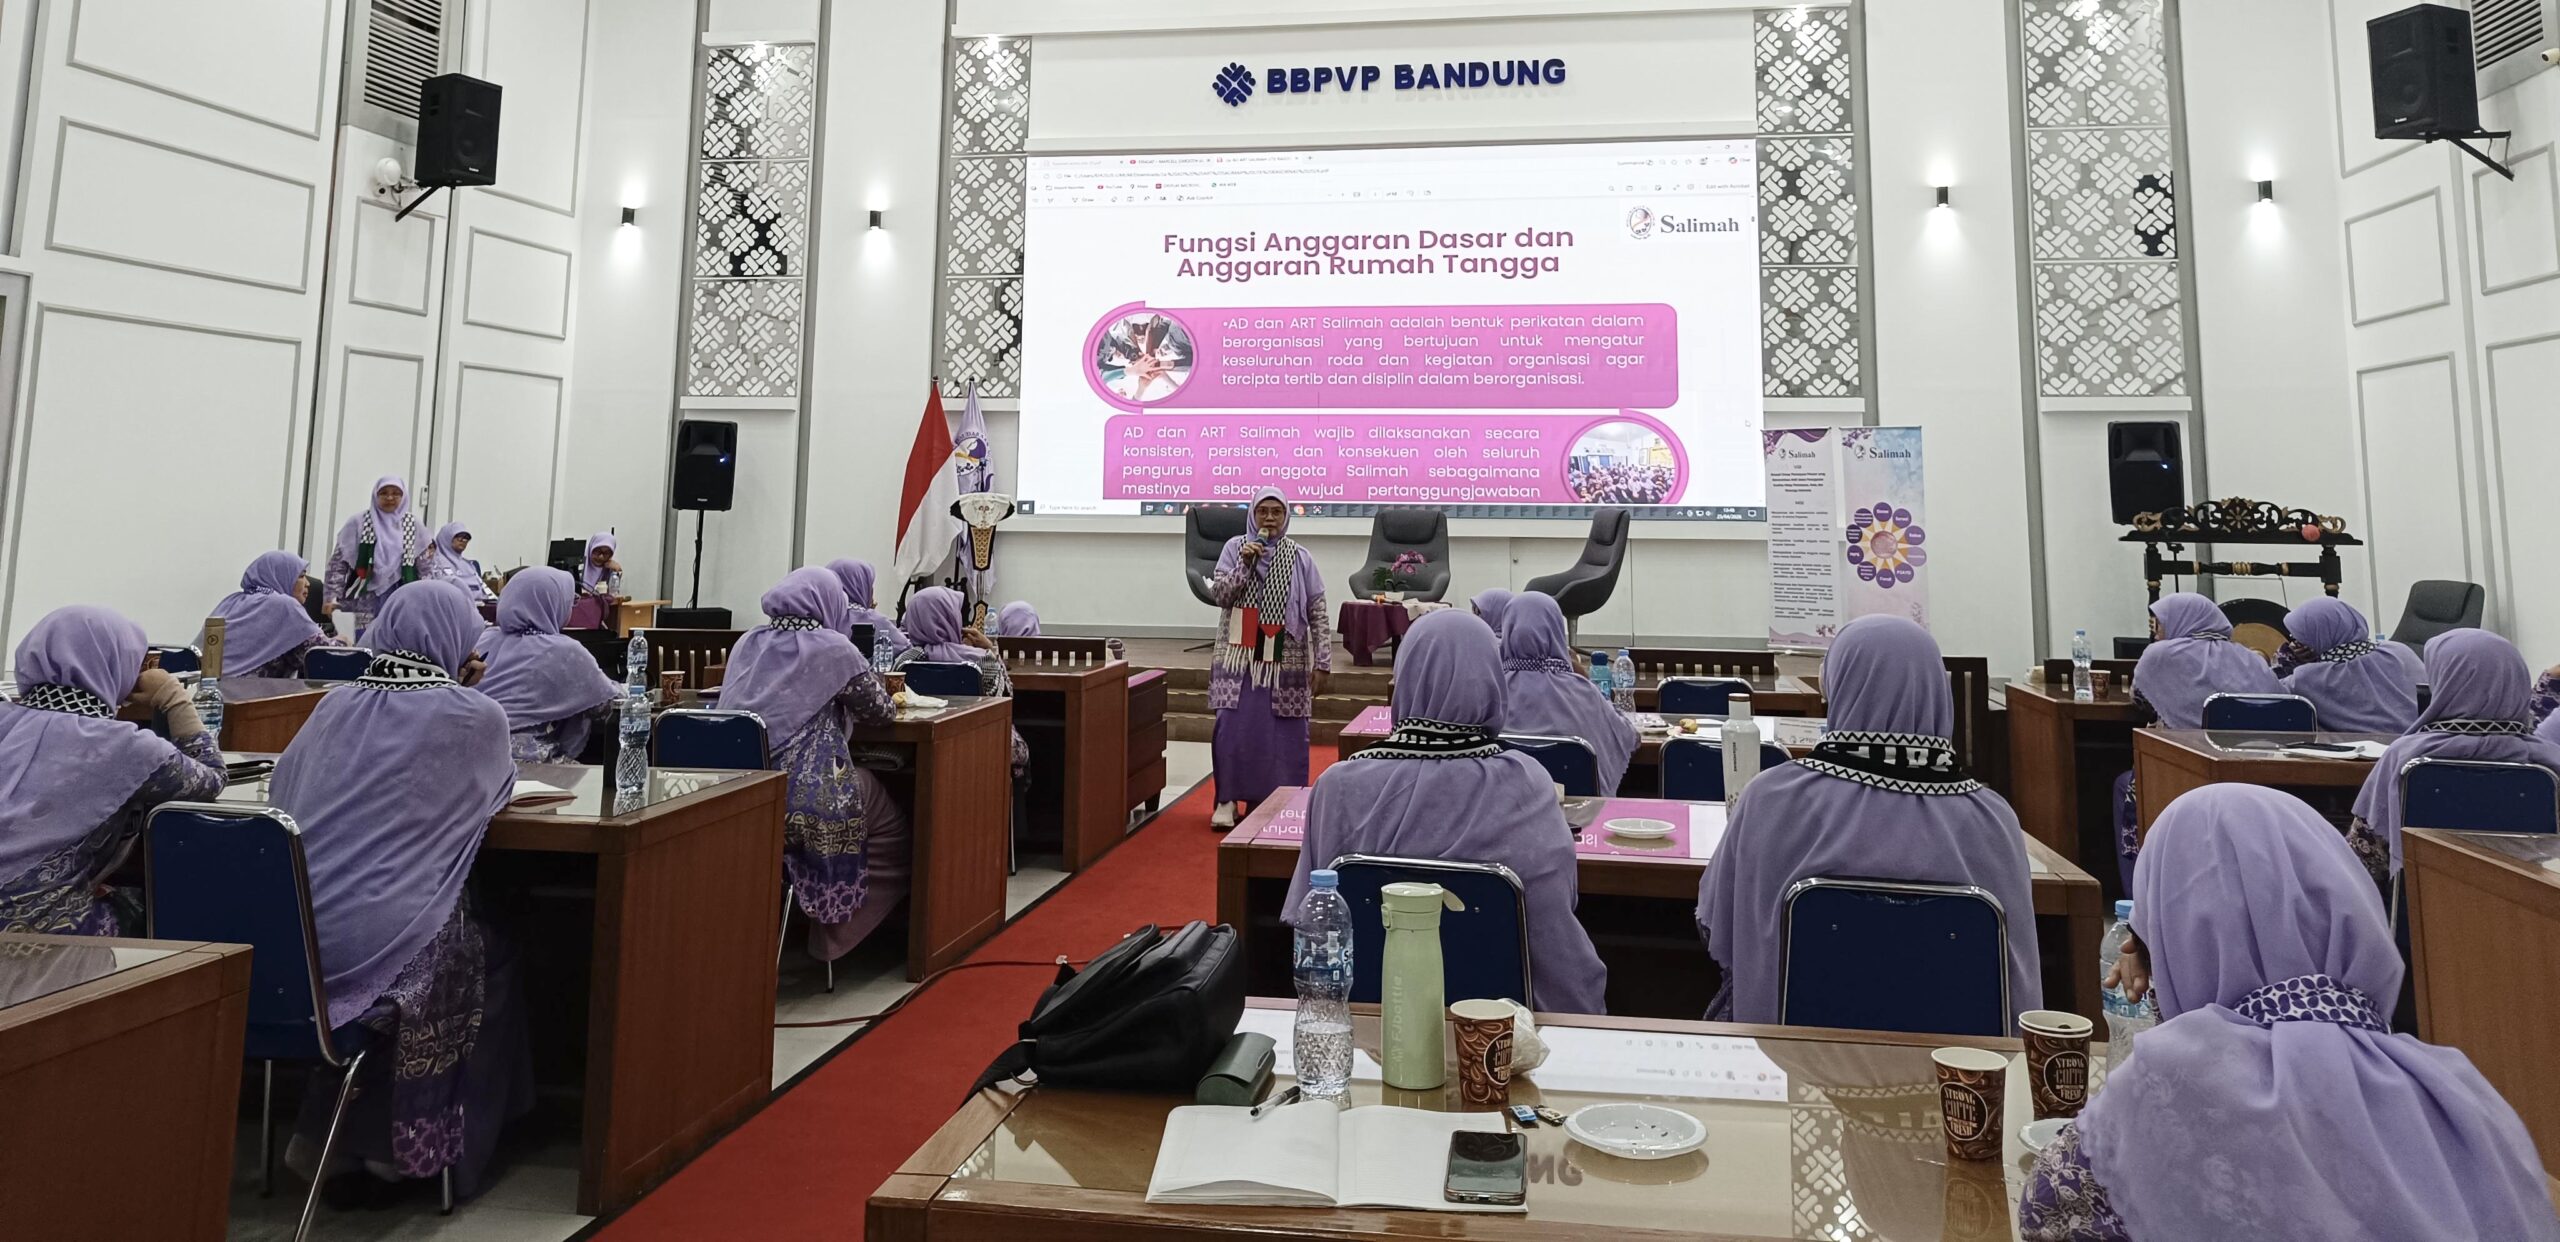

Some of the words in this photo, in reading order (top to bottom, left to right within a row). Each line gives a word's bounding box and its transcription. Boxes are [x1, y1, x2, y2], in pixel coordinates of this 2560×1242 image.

[1267, 66, 1380, 94] BBPVP
[1394, 58, 1566, 90] BANDUNG
[1660, 215, 1739, 233] Salimah
[1164, 231, 1256, 259] Fungsi
[1264, 233, 1410, 257] Anggaran
[1419, 230, 1507, 249] Dasar
[1514, 227, 1573, 248] dan
[1177, 257, 1320, 283] Anggaran
[1326, 254, 1434, 275] Rumah
[1442, 254, 1559, 279] Tangga
[1254, 317, 1284, 329] dan
[1290, 317, 1317, 329] ART
[1322, 316, 1383, 329] Salimah
[1390, 316, 1444, 328] adalah
[1451, 315, 1504, 328] bentuk
[1510, 315, 1585, 331] perikatan
[1591, 314, 1644, 327] dalam
[1223, 335, 1324, 351] berorganisasi
[1344, 337, 1383, 351] yang
[1404, 334, 1478, 350] bertujuan
[1500, 334, 1543, 346] untuk
[1564, 334, 1645, 349] mengatur
[1222, 354, 1312, 366] keseluruhan
[1328, 354, 1363, 366] roda
[1379, 354, 1409, 366] dan
[1425, 353, 1492, 369] kegiatan
[1508, 353, 1590, 369] organisasi
[1606, 355, 1645, 369] agar
[1222, 373, 1280, 388] tercipta
[1284, 372, 1323, 385] tertib
[1327, 372, 1357, 384] dan
[1362, 372, 1414, 388] disiplin
[1418, 372, 1469, 385] dalam
[1474, 372, 1584, 388] berorganisasi.
[1123, 426, 1144, 438] AD
[1157, 426, 1186, 438] dan
[1200, 426, 1226, 438] ART
[1240, 426, 1300, 438] Salimah
[1314, 426, 1354, 442] wajib
[1368, 426, 1470, 439] dilaksanakan
[1485, 429, 1539, 439] secara
[1123, 444, 1194, 459] konsisten,
[1208, 445, 1279, 460] persisten,
[1293, 445, 1323, 457] dan
[1338, 445, 1419, 458] konsekuen
[1434, 446, 1467, 458] oleh
[1483, 446, 1540, 459] seluruh
[1788, 450, 1816, 459] Salimah
[1869, 446, 1911, 458] Salimah
[1123, 466, 1193, 479] pengurus
[1212, 463, 1241, 476] dan
[1261, 465, 1326, 480] anggota
[1346, 464, 1408, 477] Salimah
[1428, 465, 1540, 481] sebagaimana
[1121, 482, 1190, 500] mestinya
[1298, 483, 1344, 499] wujud
[1368, 484, 1540, 501] pertanggungjawaban
[2055, 1057, 2085, 1068] STRONG
[1944, 1087, 1976, 1105] STRONG
[2060, 1089, 2081, 1100] FRESH
[1950, 1121, 1973, 1136] FRESH
